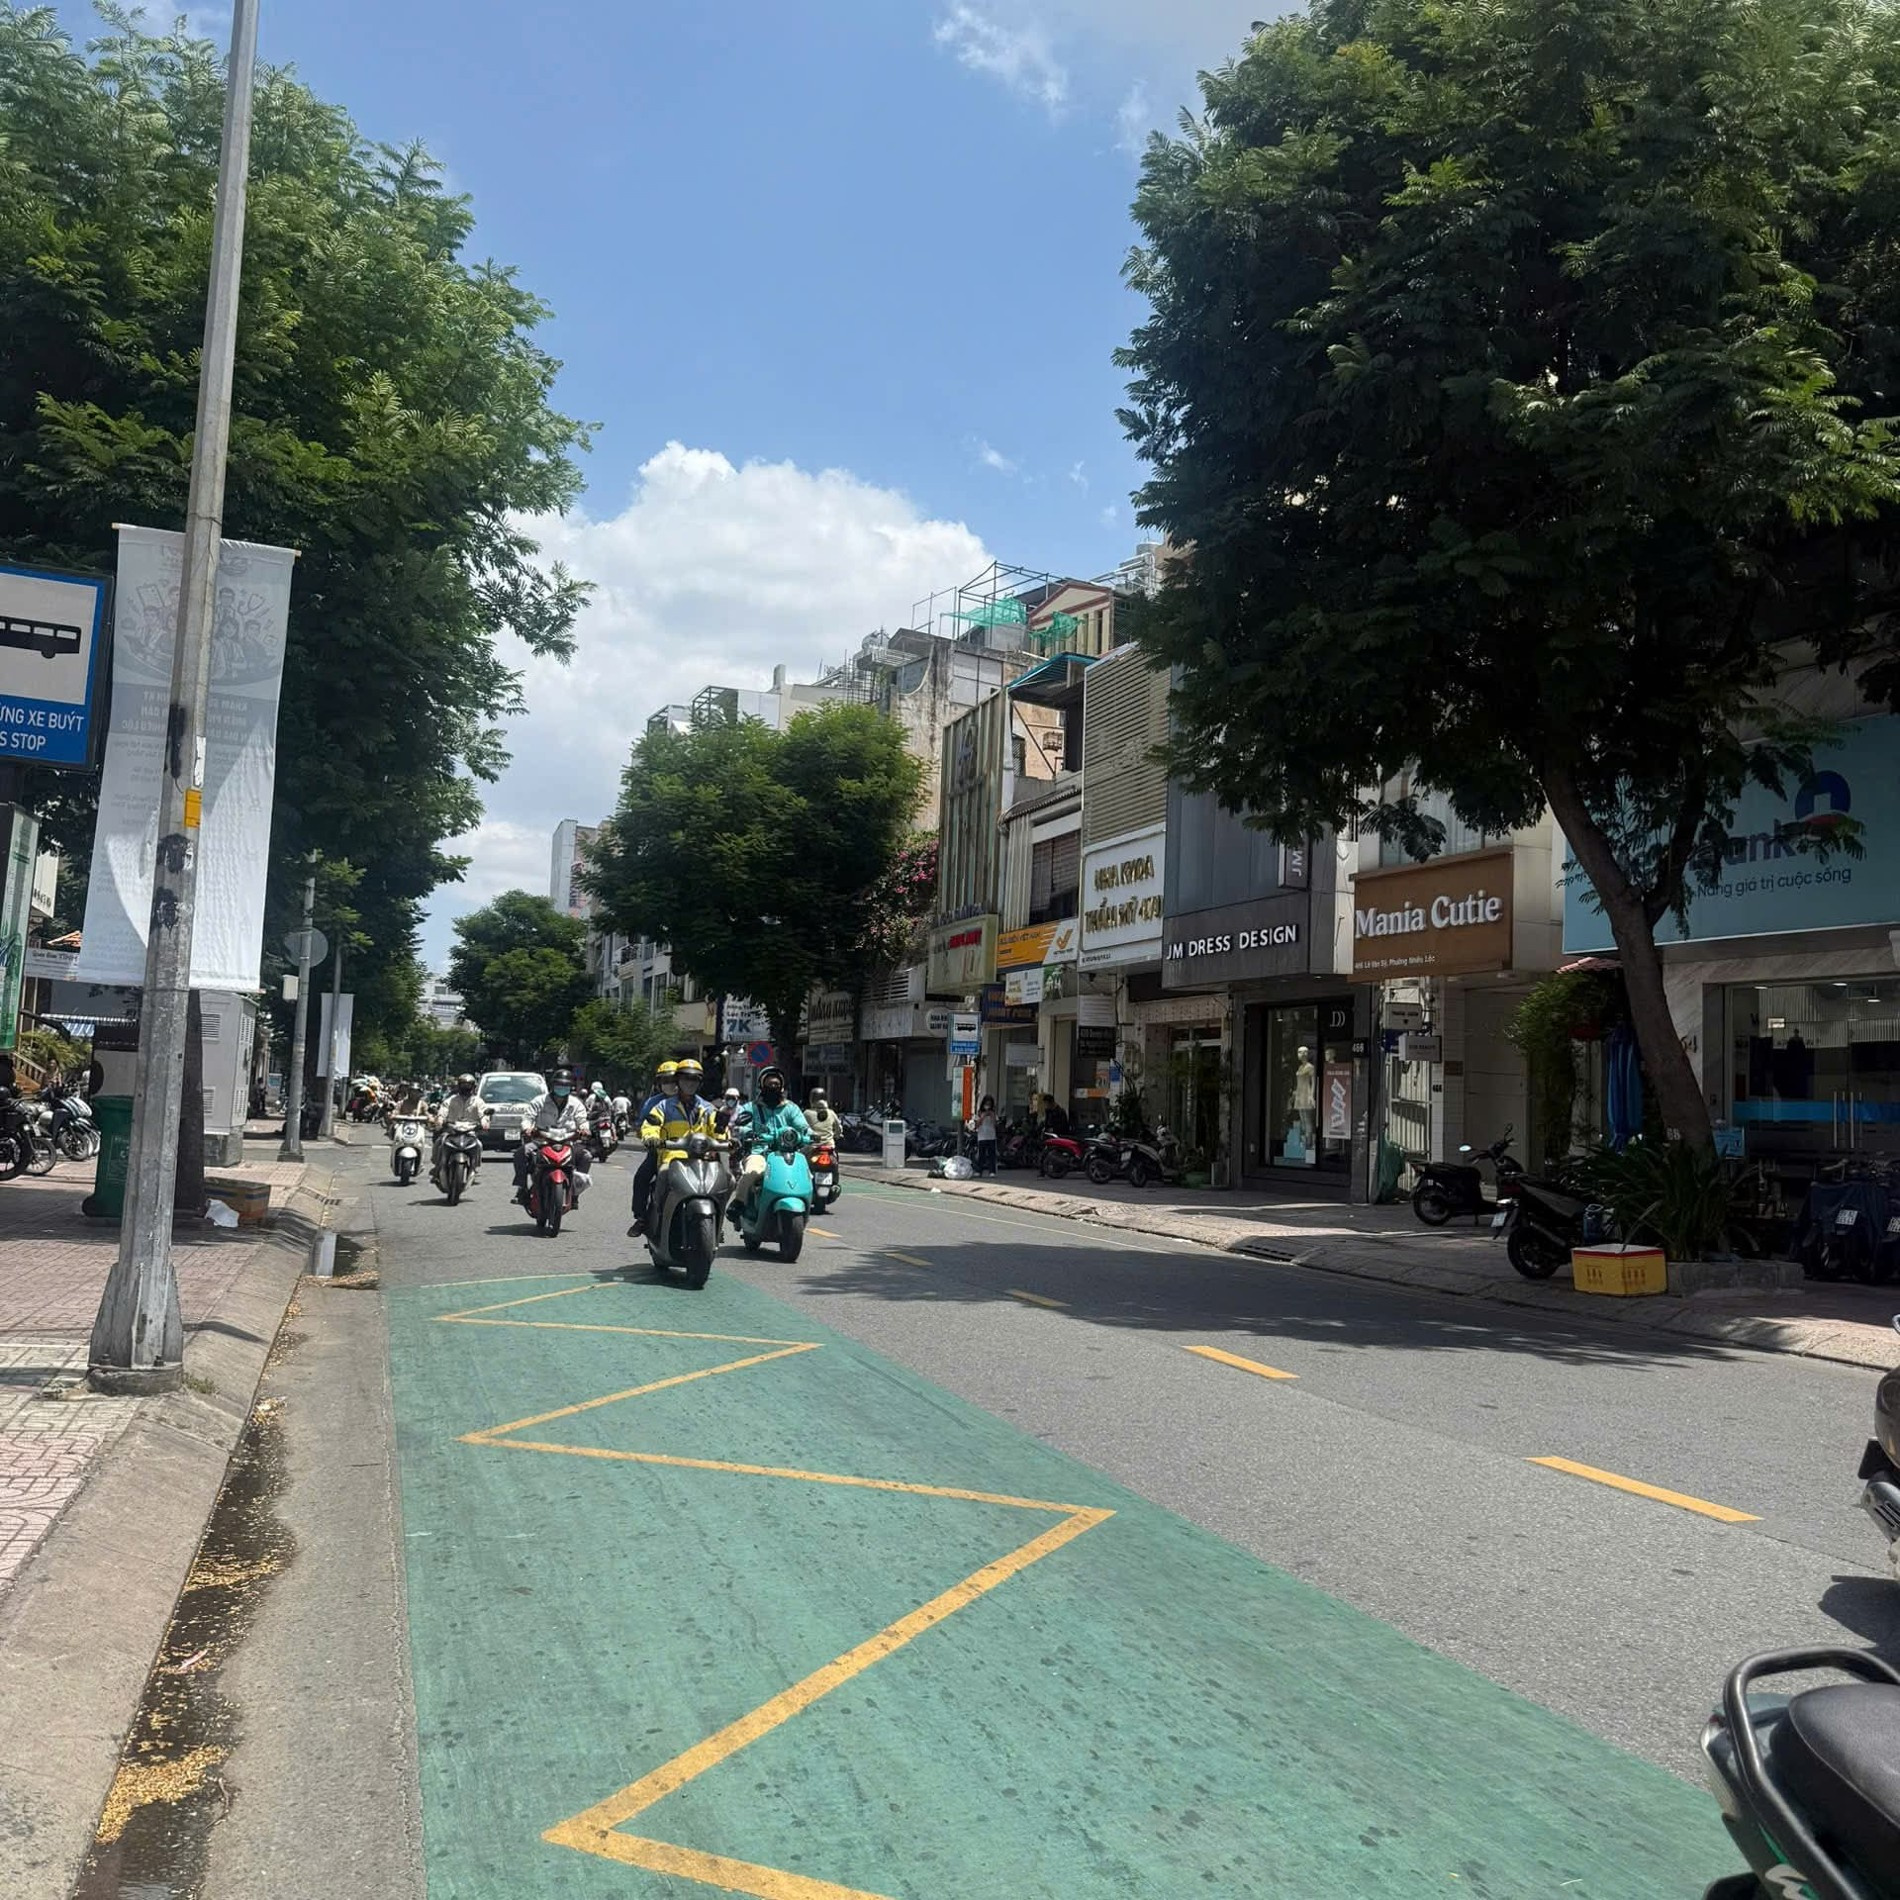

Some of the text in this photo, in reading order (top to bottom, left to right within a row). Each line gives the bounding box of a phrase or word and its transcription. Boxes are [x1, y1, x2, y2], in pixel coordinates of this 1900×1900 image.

[28, 709, 46, 727] XE
[48, 710, 84, 732] BUÝT
[11, 732, 46, 752] STOP
[1761, 875, 1774, 893] trị
[1778, 871, 1811, 891] cuộc
[1815, 866, 1851, 885] sống
[1355, 889, 1502, 939] Mania Cutie
[1166, 924, 1297, 960] JM DRESS DESIGN
[727, 1019, 751, 1032] 7K
